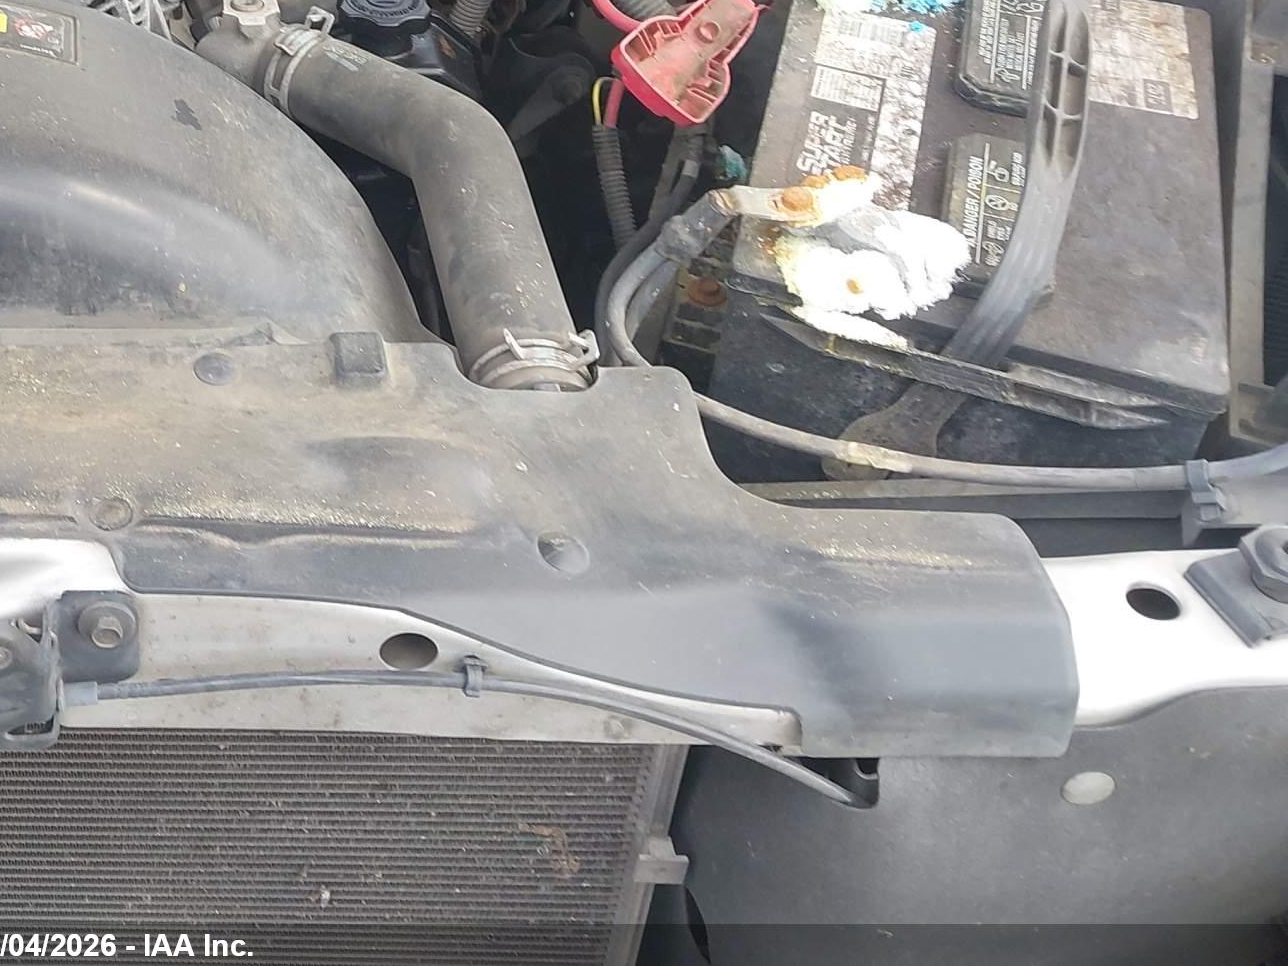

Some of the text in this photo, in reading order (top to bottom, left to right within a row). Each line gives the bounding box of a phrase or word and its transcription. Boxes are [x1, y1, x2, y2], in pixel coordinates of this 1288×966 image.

[796, 111, 829, 173] SUPER
[967, 155, 984, 190] POISON
[963, 197, 981, 237] DANGER
